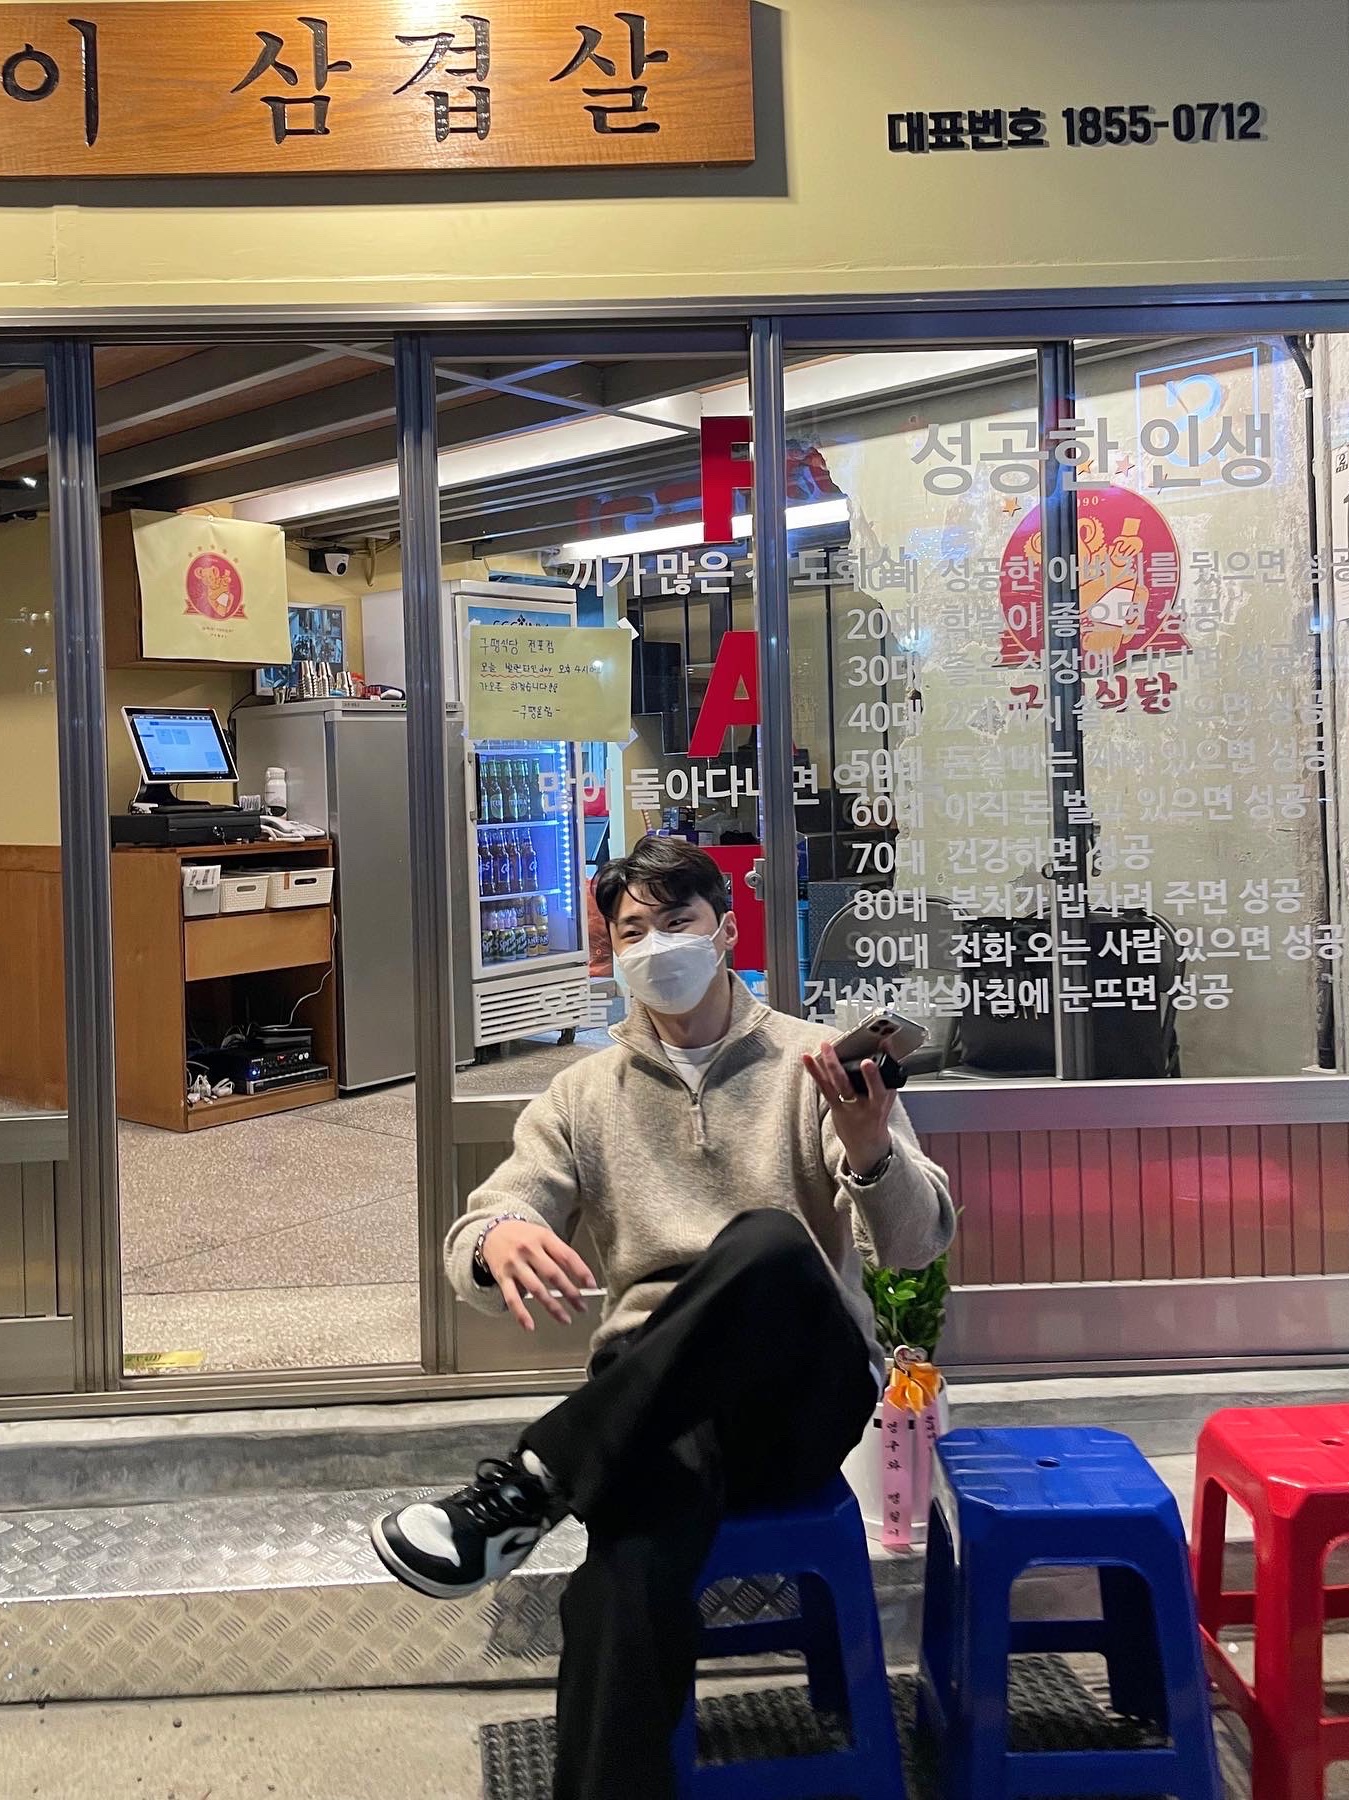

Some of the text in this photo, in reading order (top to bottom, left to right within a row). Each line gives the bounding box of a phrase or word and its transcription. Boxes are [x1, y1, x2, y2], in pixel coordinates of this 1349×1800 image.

[231, 12, 669, 146] 삼겹살
[887, 101, 1265, 153] 대표번호 1855-0712
[910, 413, 1273, 495] 성공한 인생
[567, 553, 647, 597] 끼가
[655, 549, 735, 596] 많은
[940, 554, 1039, 593] 성공한
[846, 606, 919, 640] 20대
[1157, 599, 1222, 634] 성공
[848, 653, 922, 687] 30대
[1009, 671, 1179, 715] 구식당
[849, 699, 922, 735] 40대
[851, 792, 924, 828] 60대
[945, 791, 1010, 828] 아직
[851, 833, 1153, 876] 70대 건강하면 성공
[853, 886, 928, 923] 80대
[947, 883, 1049, 921] 본처가
[1163, 879, 1228, 916] 주면
[1238, 878, 1305, 915] 성공
[854, 923, 1346, 969] 90대 전화 오는 사람 있으면 성공
[948, 977, 1050, 1016] 아침에
[1057, 974, 1158, 1014] 눈뜨면
[1166, 974, 1234, 1011] 성공
